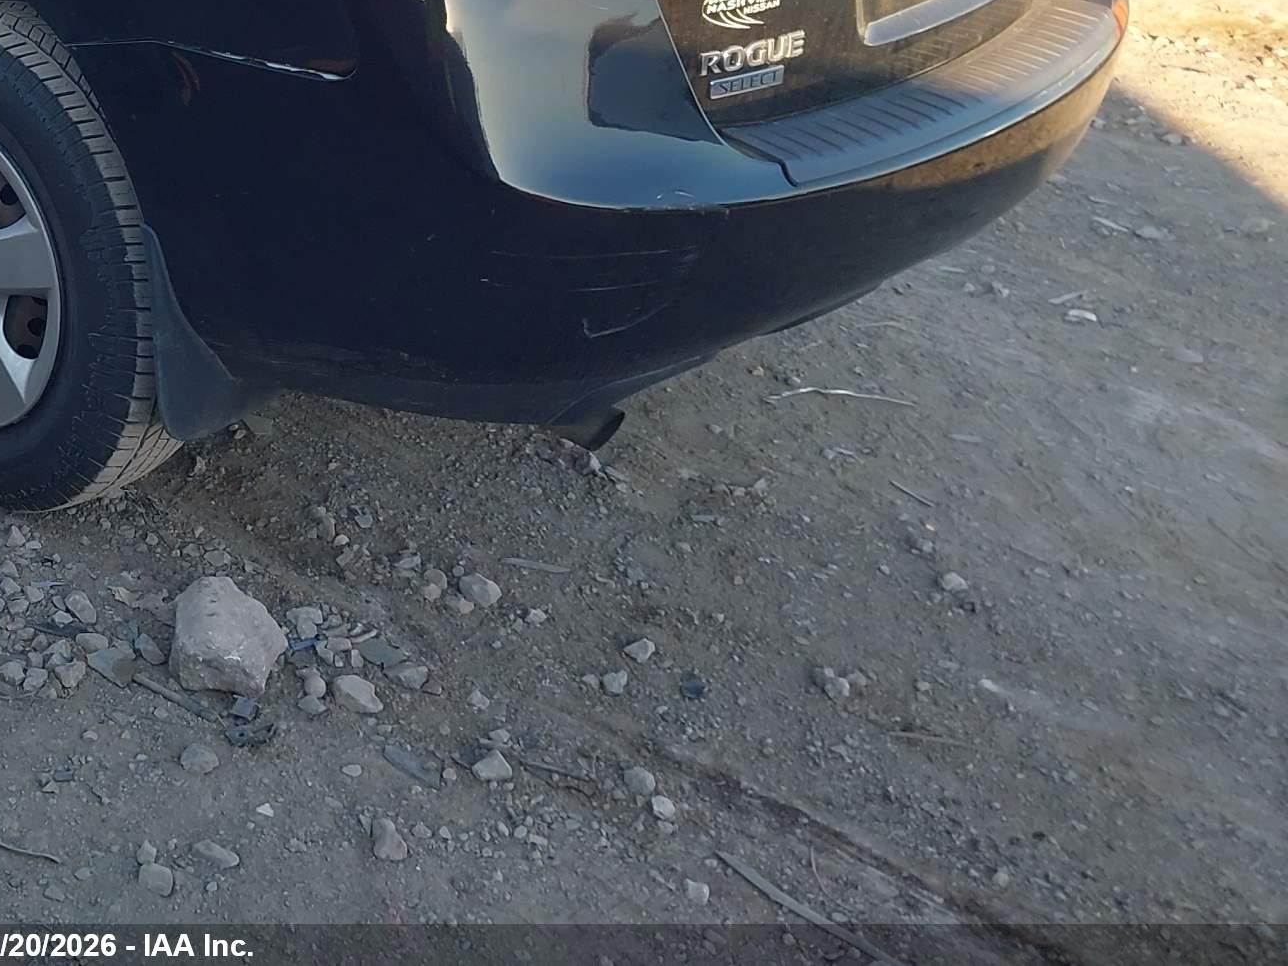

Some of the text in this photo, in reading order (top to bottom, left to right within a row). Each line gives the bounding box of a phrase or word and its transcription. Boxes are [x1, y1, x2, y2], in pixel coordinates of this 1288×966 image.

[743, 0, 781, 15] NISSAN
[699, 29, 806, 77] ROGUE
[718, 71, 777, 94] SELECT
